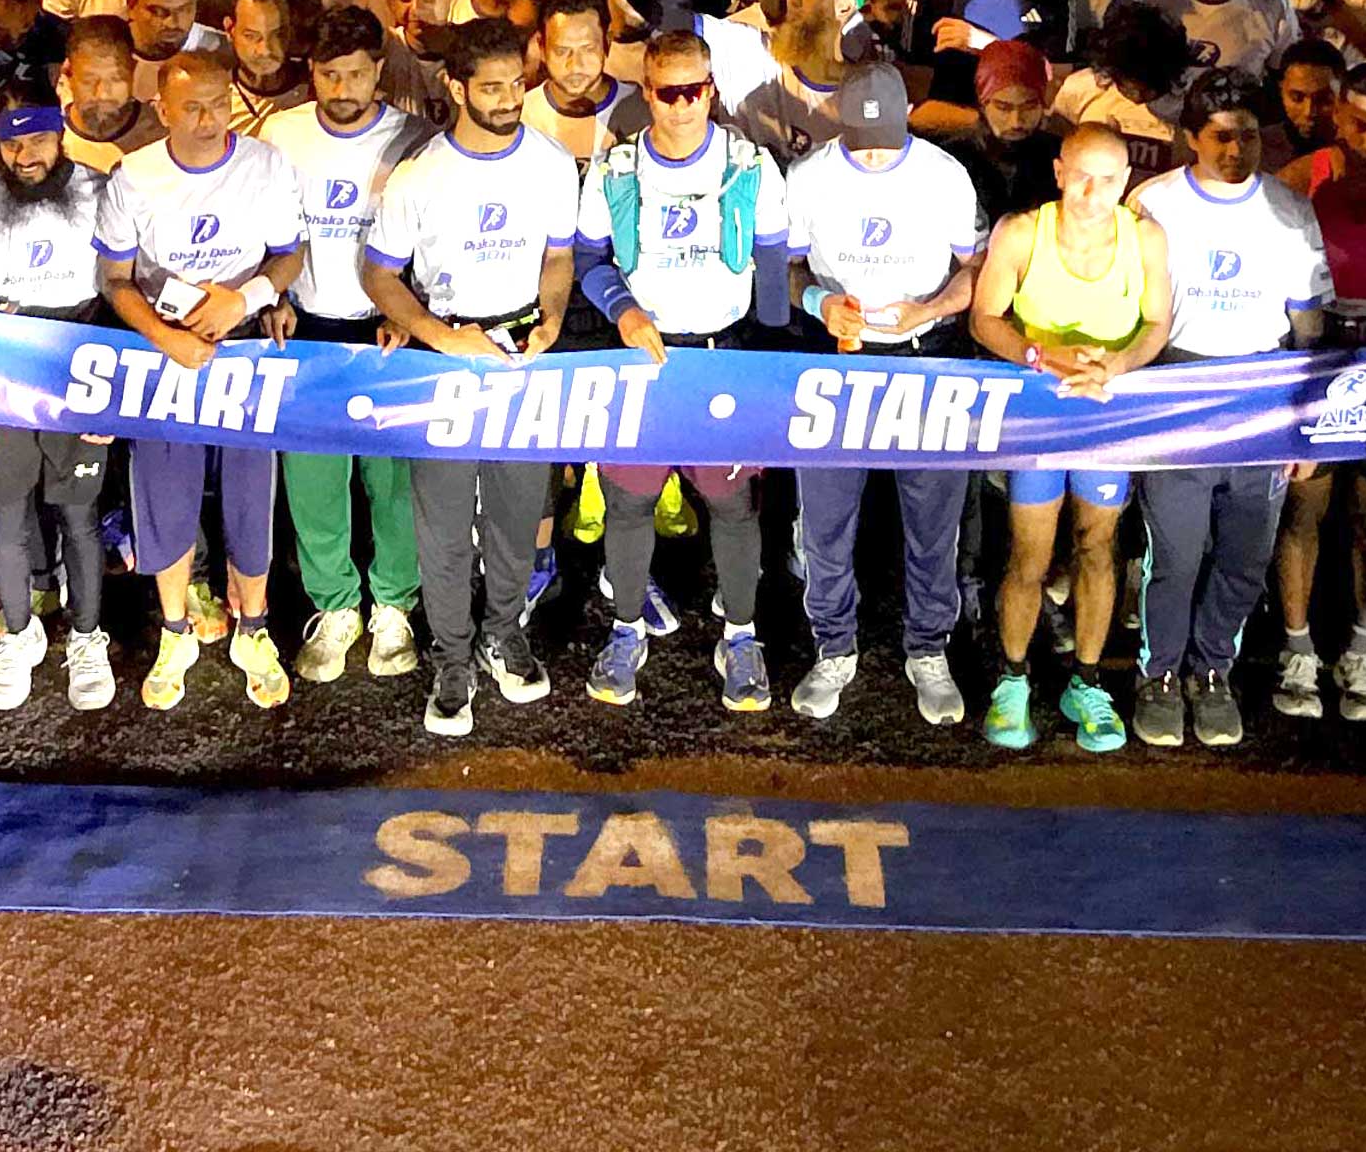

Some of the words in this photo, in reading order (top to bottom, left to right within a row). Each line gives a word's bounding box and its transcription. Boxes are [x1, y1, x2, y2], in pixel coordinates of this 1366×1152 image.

[65, 342, 299, 434] START
[425, 361, 663, 450] START
[787, 368, 1025, 452] START
[363, 809, 910, 909] START
